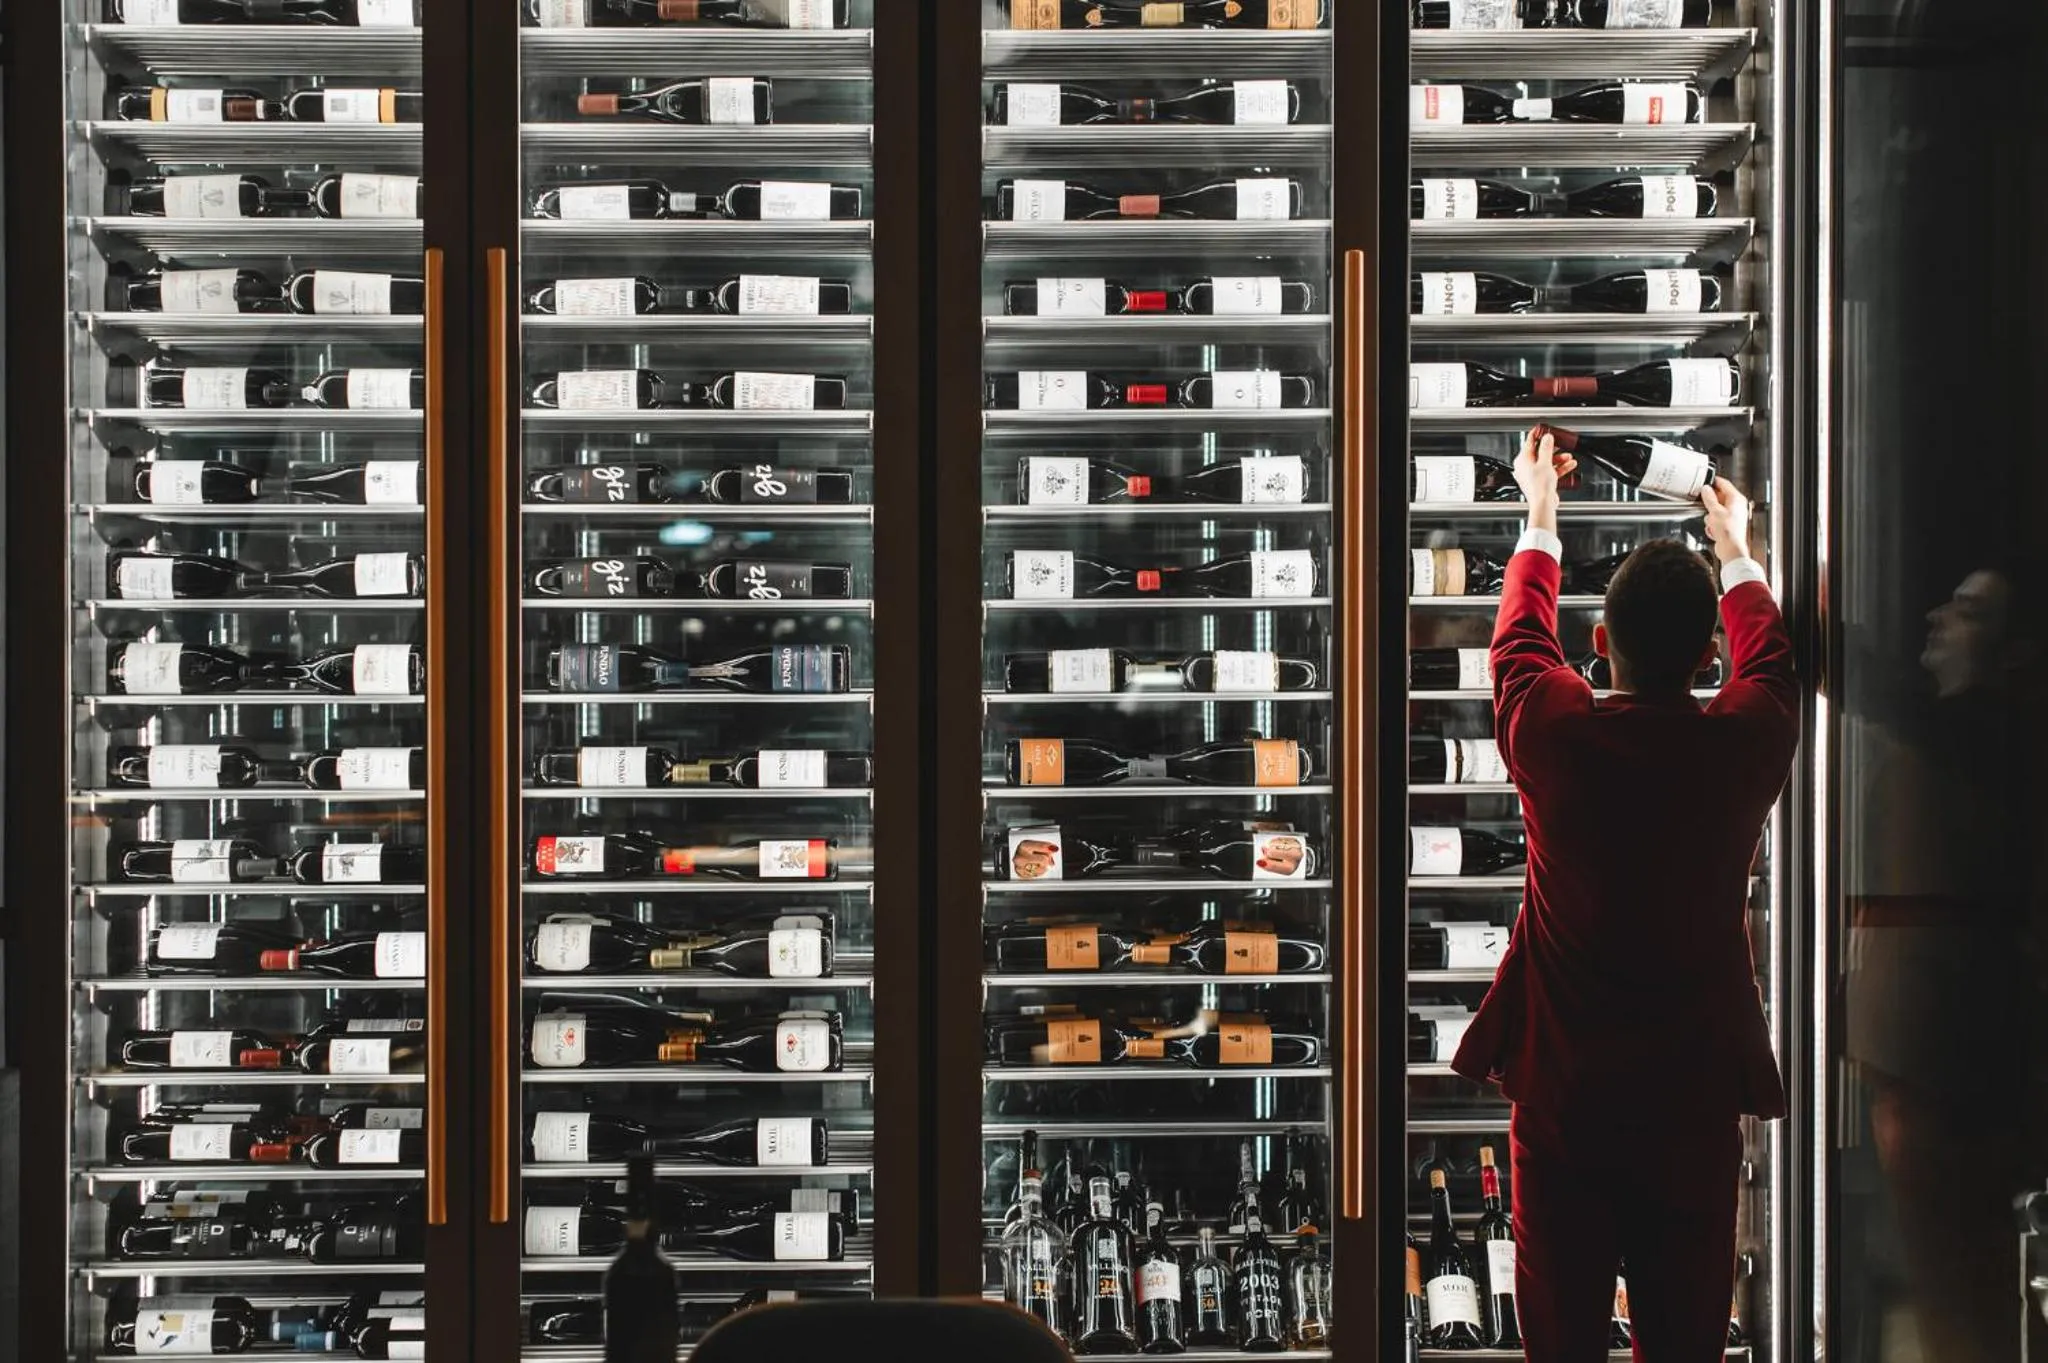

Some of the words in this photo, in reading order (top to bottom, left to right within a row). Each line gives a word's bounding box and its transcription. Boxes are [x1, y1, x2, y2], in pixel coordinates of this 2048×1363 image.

[592, 467, 631, 501] giz
[750, 464, 787, 497] giz
[592, 560, 631, 596] giz
[743, 565, 782, 600] giz
[1240, 1274, 1280, 1291] 2003
[1246, 1309, 1279, 1321] PORT
